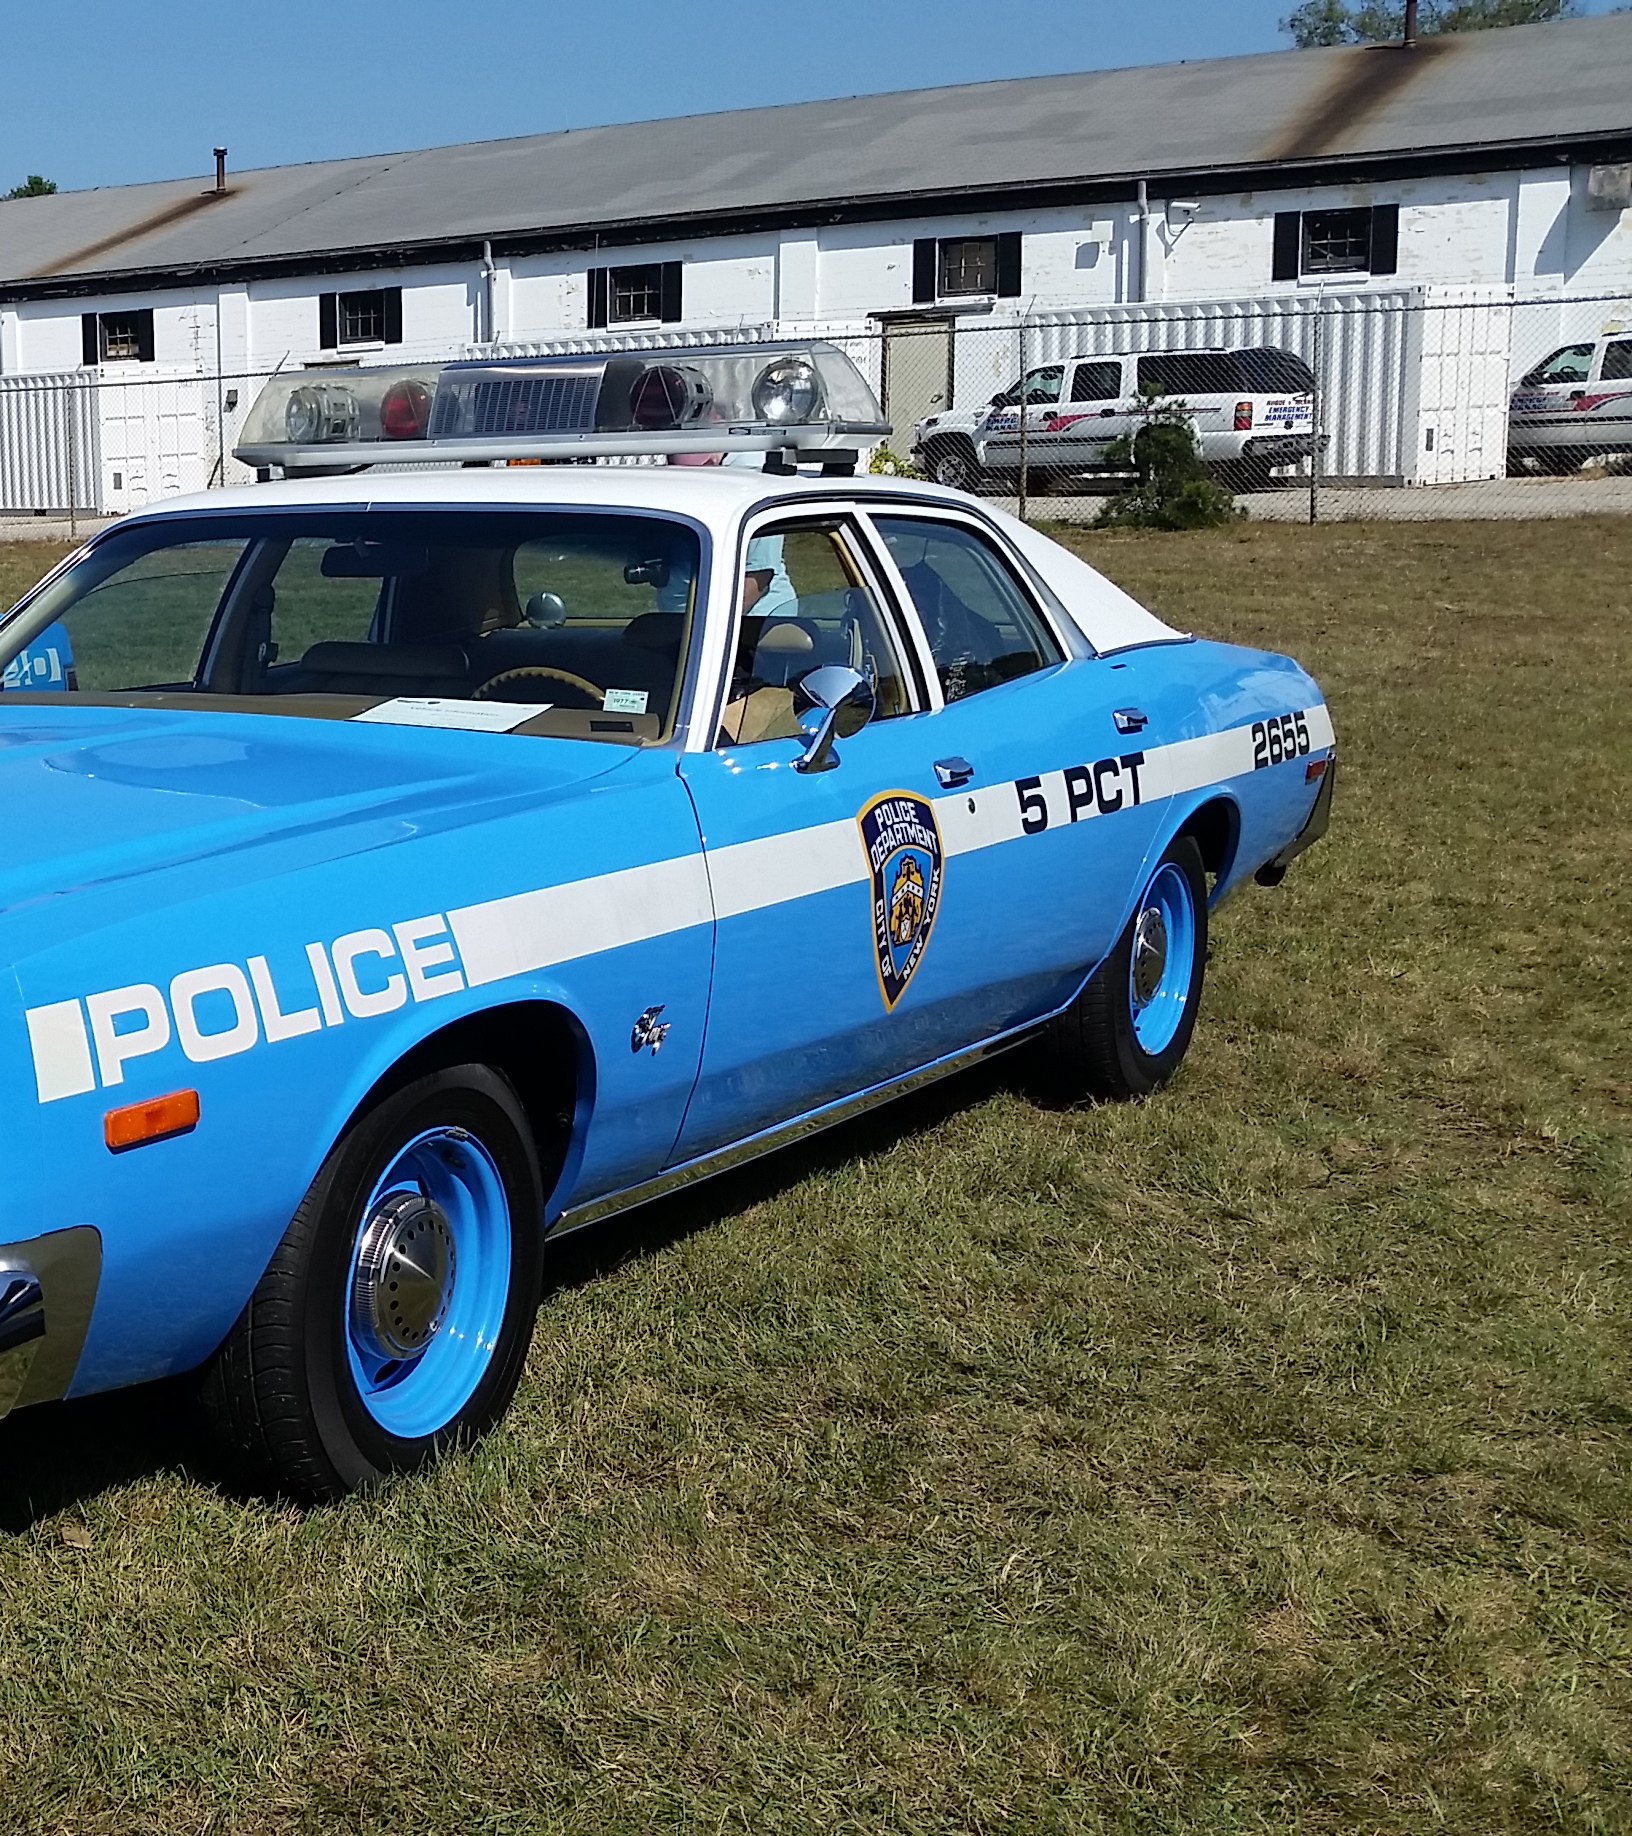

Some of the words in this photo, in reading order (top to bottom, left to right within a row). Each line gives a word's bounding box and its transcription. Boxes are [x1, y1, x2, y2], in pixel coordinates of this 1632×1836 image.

[1264, 413, 1313, 421] MANAGEMENT
[1268, 406, 1310, 414] EMERGENCY
[1250, 710, 1311, 770] 2655
[874, 800, 920, 832] POLICE
[1015, 776, 1048, 835] 5
[1065, 751, 1146, 823] PCT
[870, 822, 939, 874] DEPARTMENT
[875, 898, 888, 950] CITY
[902, 935, 924, 981] NEW
[922, 867, 941, 926] YORK
[880, 954, 892, 978] OF
[85, 913, 466, 1087] POLICE
